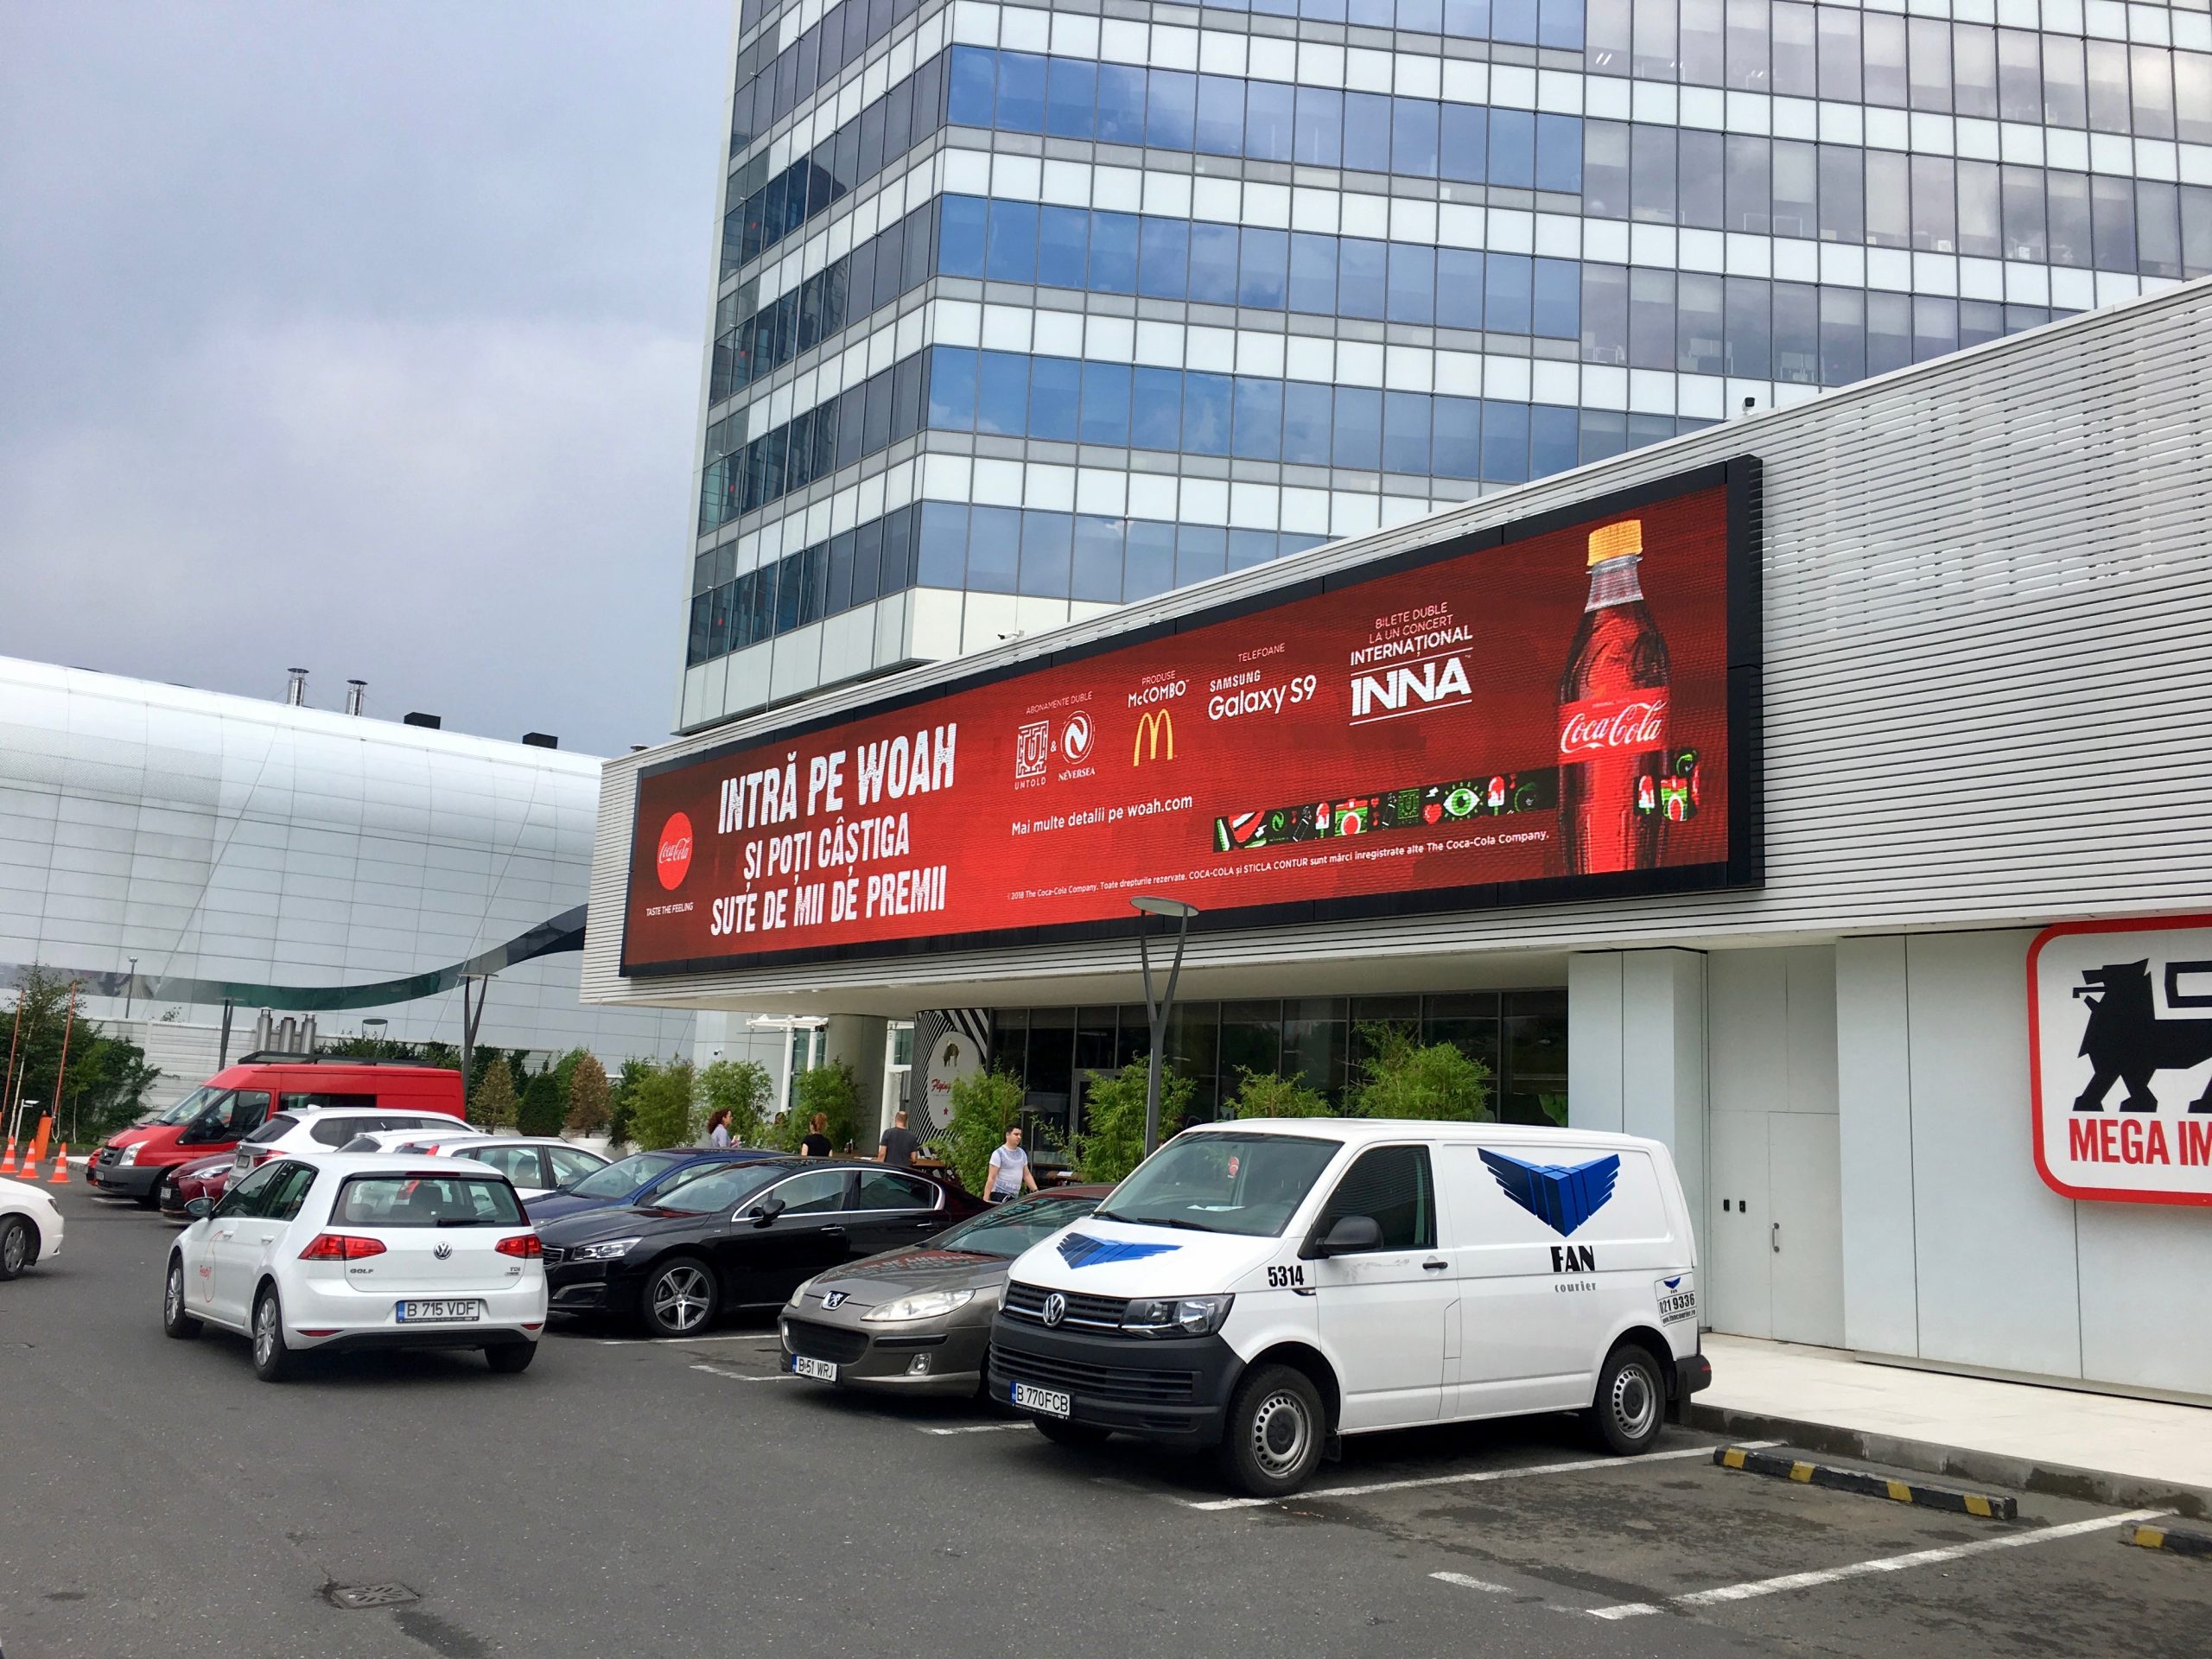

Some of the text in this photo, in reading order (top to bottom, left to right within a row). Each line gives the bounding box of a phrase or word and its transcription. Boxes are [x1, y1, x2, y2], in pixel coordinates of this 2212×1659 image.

[1376, 601, 1448, 629] BILETE DUBLE
[1370, 614, 1453, 644] LA UN CONCERT
[1237, 643, 1286, 663] TELEFOANE
[1351, 625, 1473, 666] INTERNAȚIONAL
[1141, 670, 1177, 686] PRODUSE
[1210, 670, 1261, 693] SAMSUNG
[1351, 657, 1472, 717] INNA
[1026, 690, 1093, 715] ABONAMENTE DUBLE
[1208, 674, 1318, 721] Galaxy S9
[1050, 740, 1057, 753] &
[718, 722, 957, 835] INTRĂ PE WOAH
[1014, 777, 1046, 791] UNTOLD
[1058, 767, 1096, 781] NEVERSEA
[1011, 795, 1193, 836] Mai multe detalii pe woah.com
[817, 812, 909, 877] CÂȘTIGA
[1011, 891, 1025, 900] 2018
[1026, 890, 1036, 899] The
[1037, 887, 1068, 897] Coca-Cola
[1068, 883, 1099, 894] Company.
[1100, 881, 1119, 891] Toate
[1119, 875, 1152, 888] drepturile
[1153, 873, 1187, 884] rezervate.
[1188, 867, 1234, 880] COCA-COLA
[1243, 861, 1272, 874] STICLA
[1273, 857, 1308, 870] CONTUR
[1309, 855, 1328, 866] sunt
[1406, 843, 1424, 855] alte
[1427, 842, 1444, 853] The
[1446, 835, 1497, 850] Coca-Cola
[1497, 830, 1549, 845] Company.
[646, 902, 694, 917] TASTE THE FEELING
[710, 865, 947, 936] SUTE DE MII DE PREMII
[2069, 1118, 2171, 1166] MEGA
[1550, 1245, 1595, 1273] FAN
[1267, 1264, 1305, 1287] 5314
[1554, 1281, 1596, 1293] courier
[407, 1301, 476, 1317] B 715 VDF
[1659, 1293, 1695, 1314] 021 9336
[798, 1357, 834, 1379] B 51 WRJ
[1017, 1385, 1024, 1402] B
